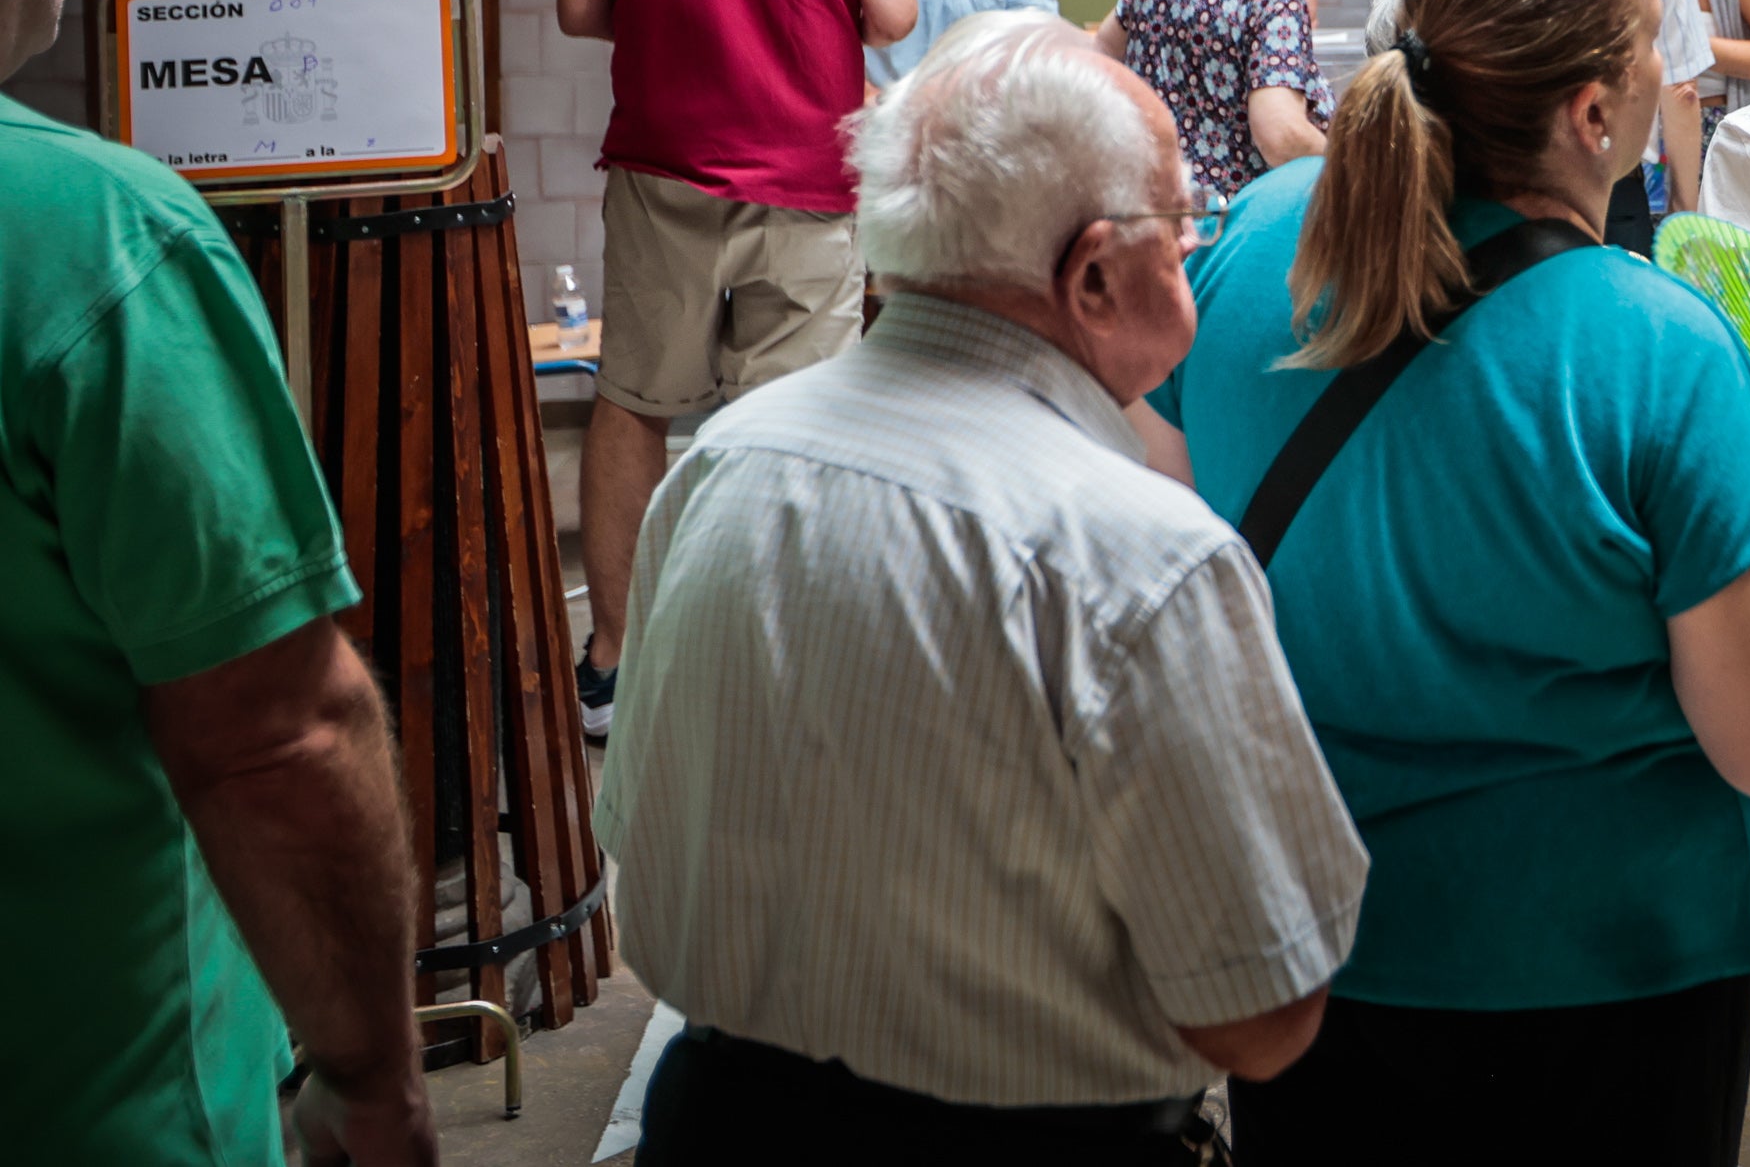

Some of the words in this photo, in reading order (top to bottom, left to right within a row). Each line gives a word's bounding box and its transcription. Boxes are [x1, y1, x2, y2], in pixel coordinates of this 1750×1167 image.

[137, 0, 244, 22] SECCIÓN
[140, 55, 273, 90] MESA
[168, 153, 183, 166] la
[189, 152, 228, 165] letra
[306, 149, 315, 158] a
[321, 145, 335, 157] la
